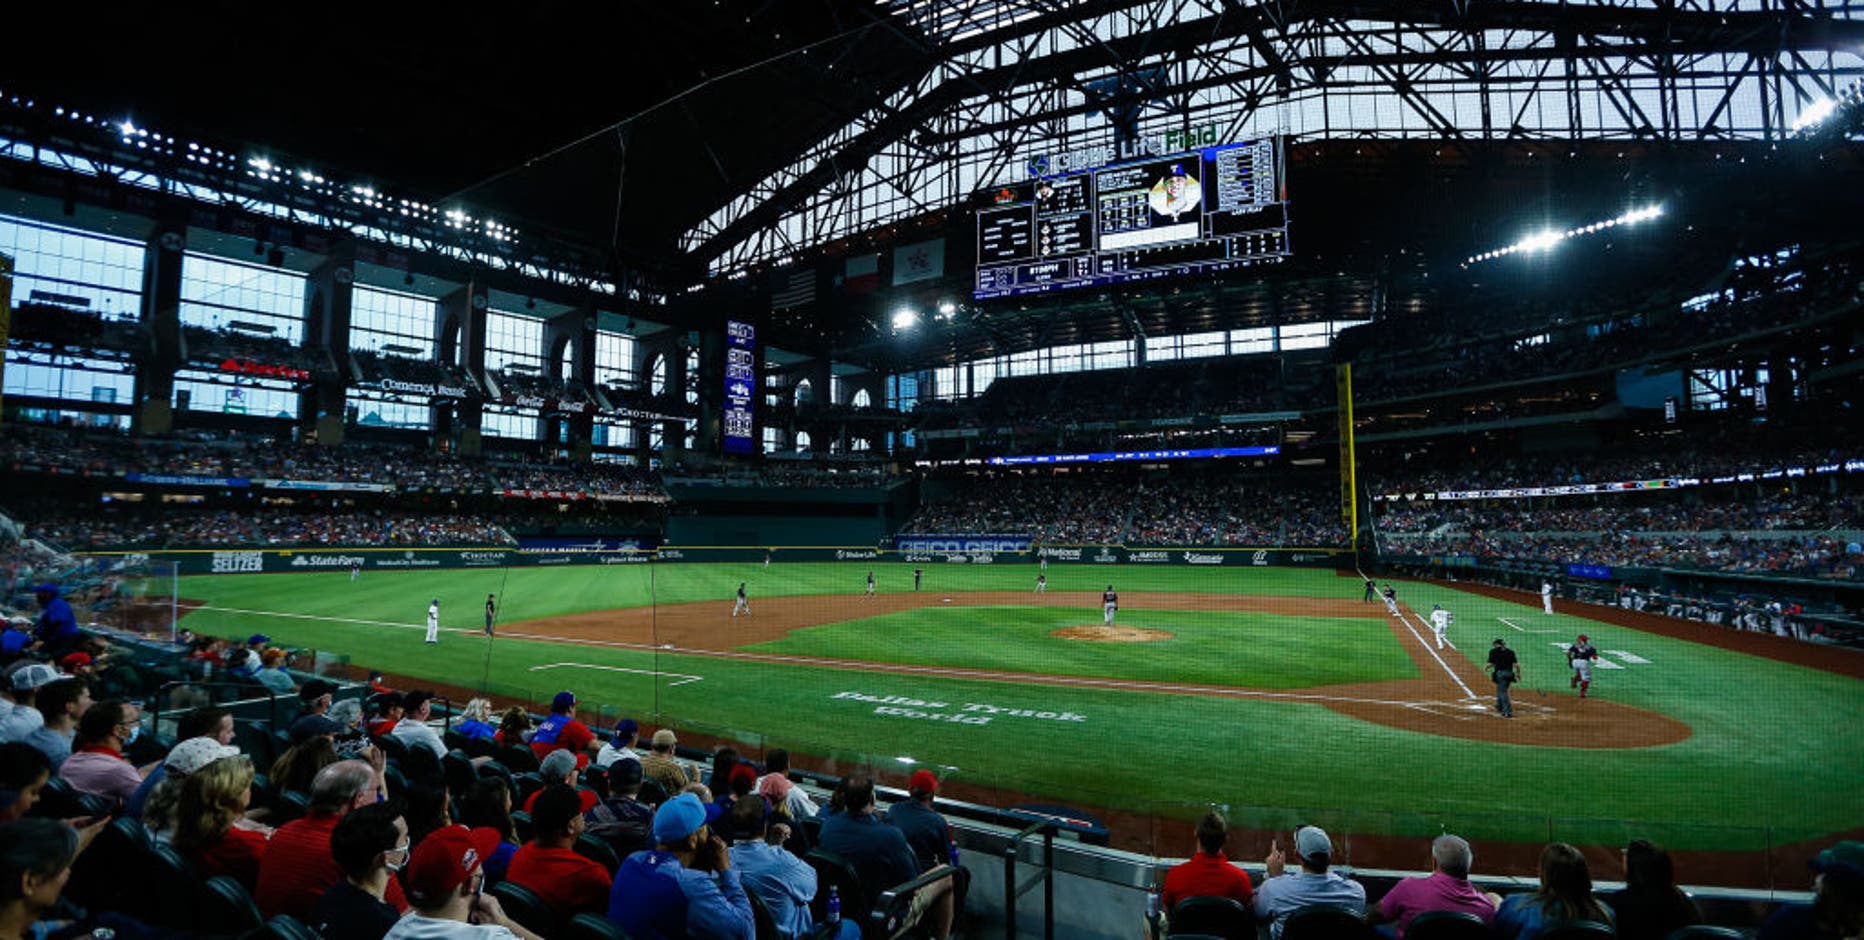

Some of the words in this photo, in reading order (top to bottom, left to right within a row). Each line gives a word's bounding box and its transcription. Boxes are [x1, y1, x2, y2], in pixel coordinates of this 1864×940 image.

[1056, 147, 1116, 171] Globe
[1120, 136, 1162, 159] Life
[1166, 124, 1217, 152] Field
[211, 557, 263, 572] SELTZER
